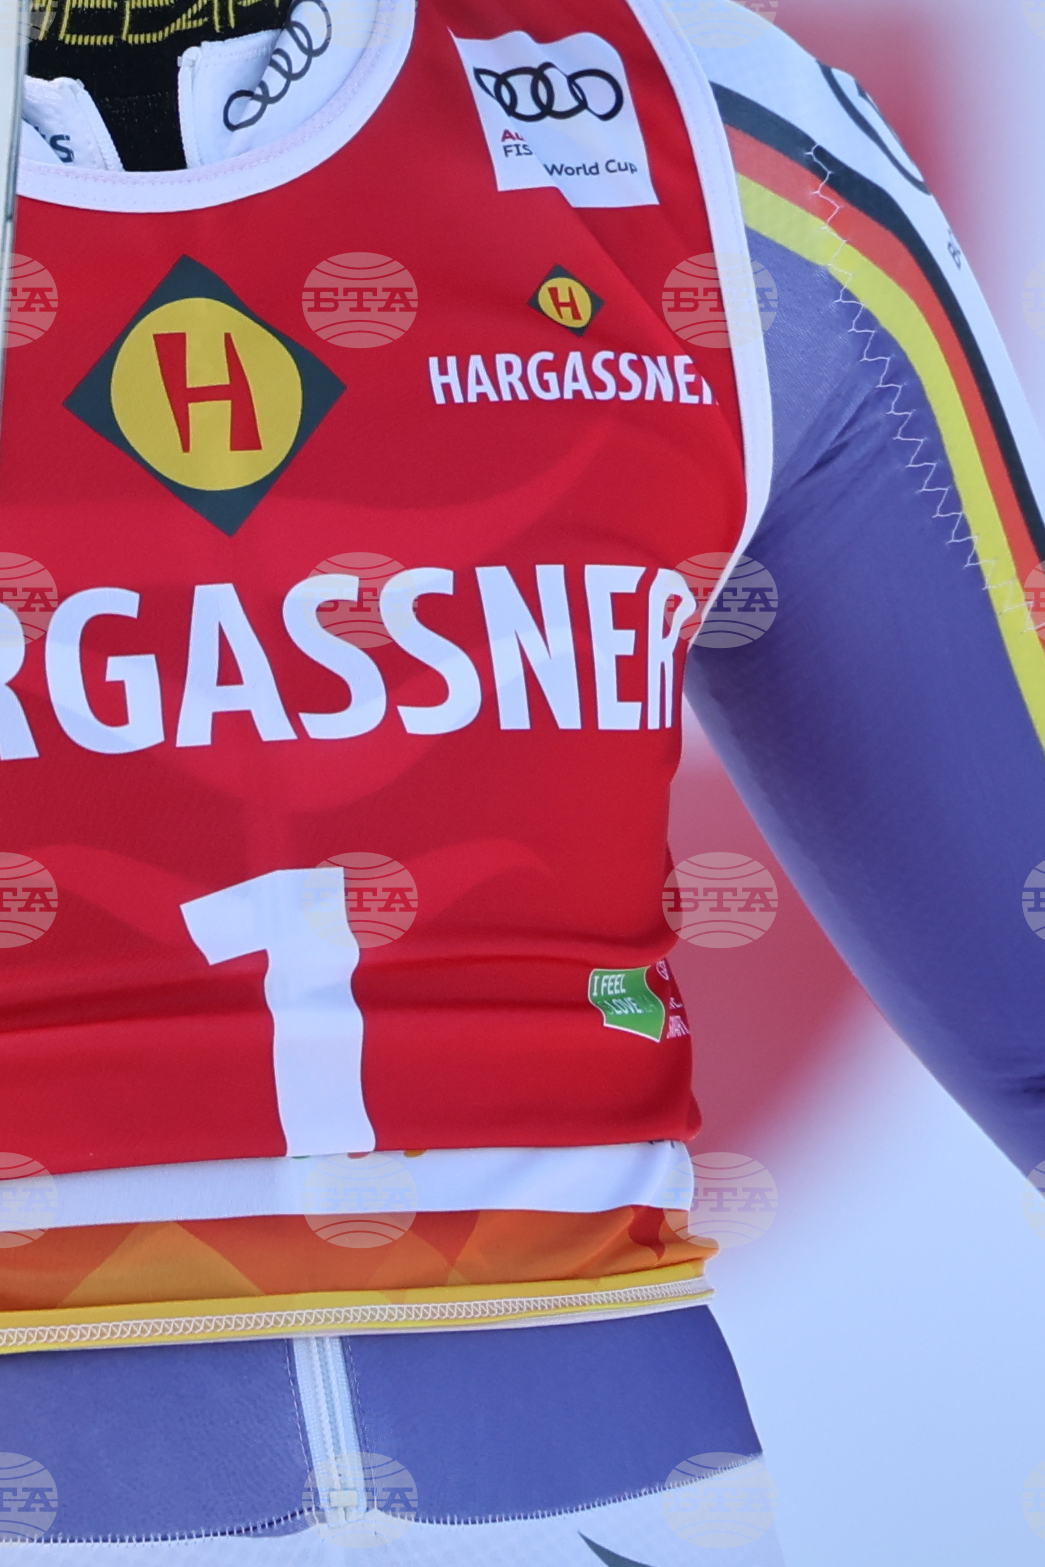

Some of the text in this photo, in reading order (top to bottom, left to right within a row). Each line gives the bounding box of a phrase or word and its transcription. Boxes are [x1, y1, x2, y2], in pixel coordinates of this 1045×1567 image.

[502, 143, 639, 177] FIS World Cup
[601, 973, 627, 996] FEEL
[180, 866, 377, 1157] 1
